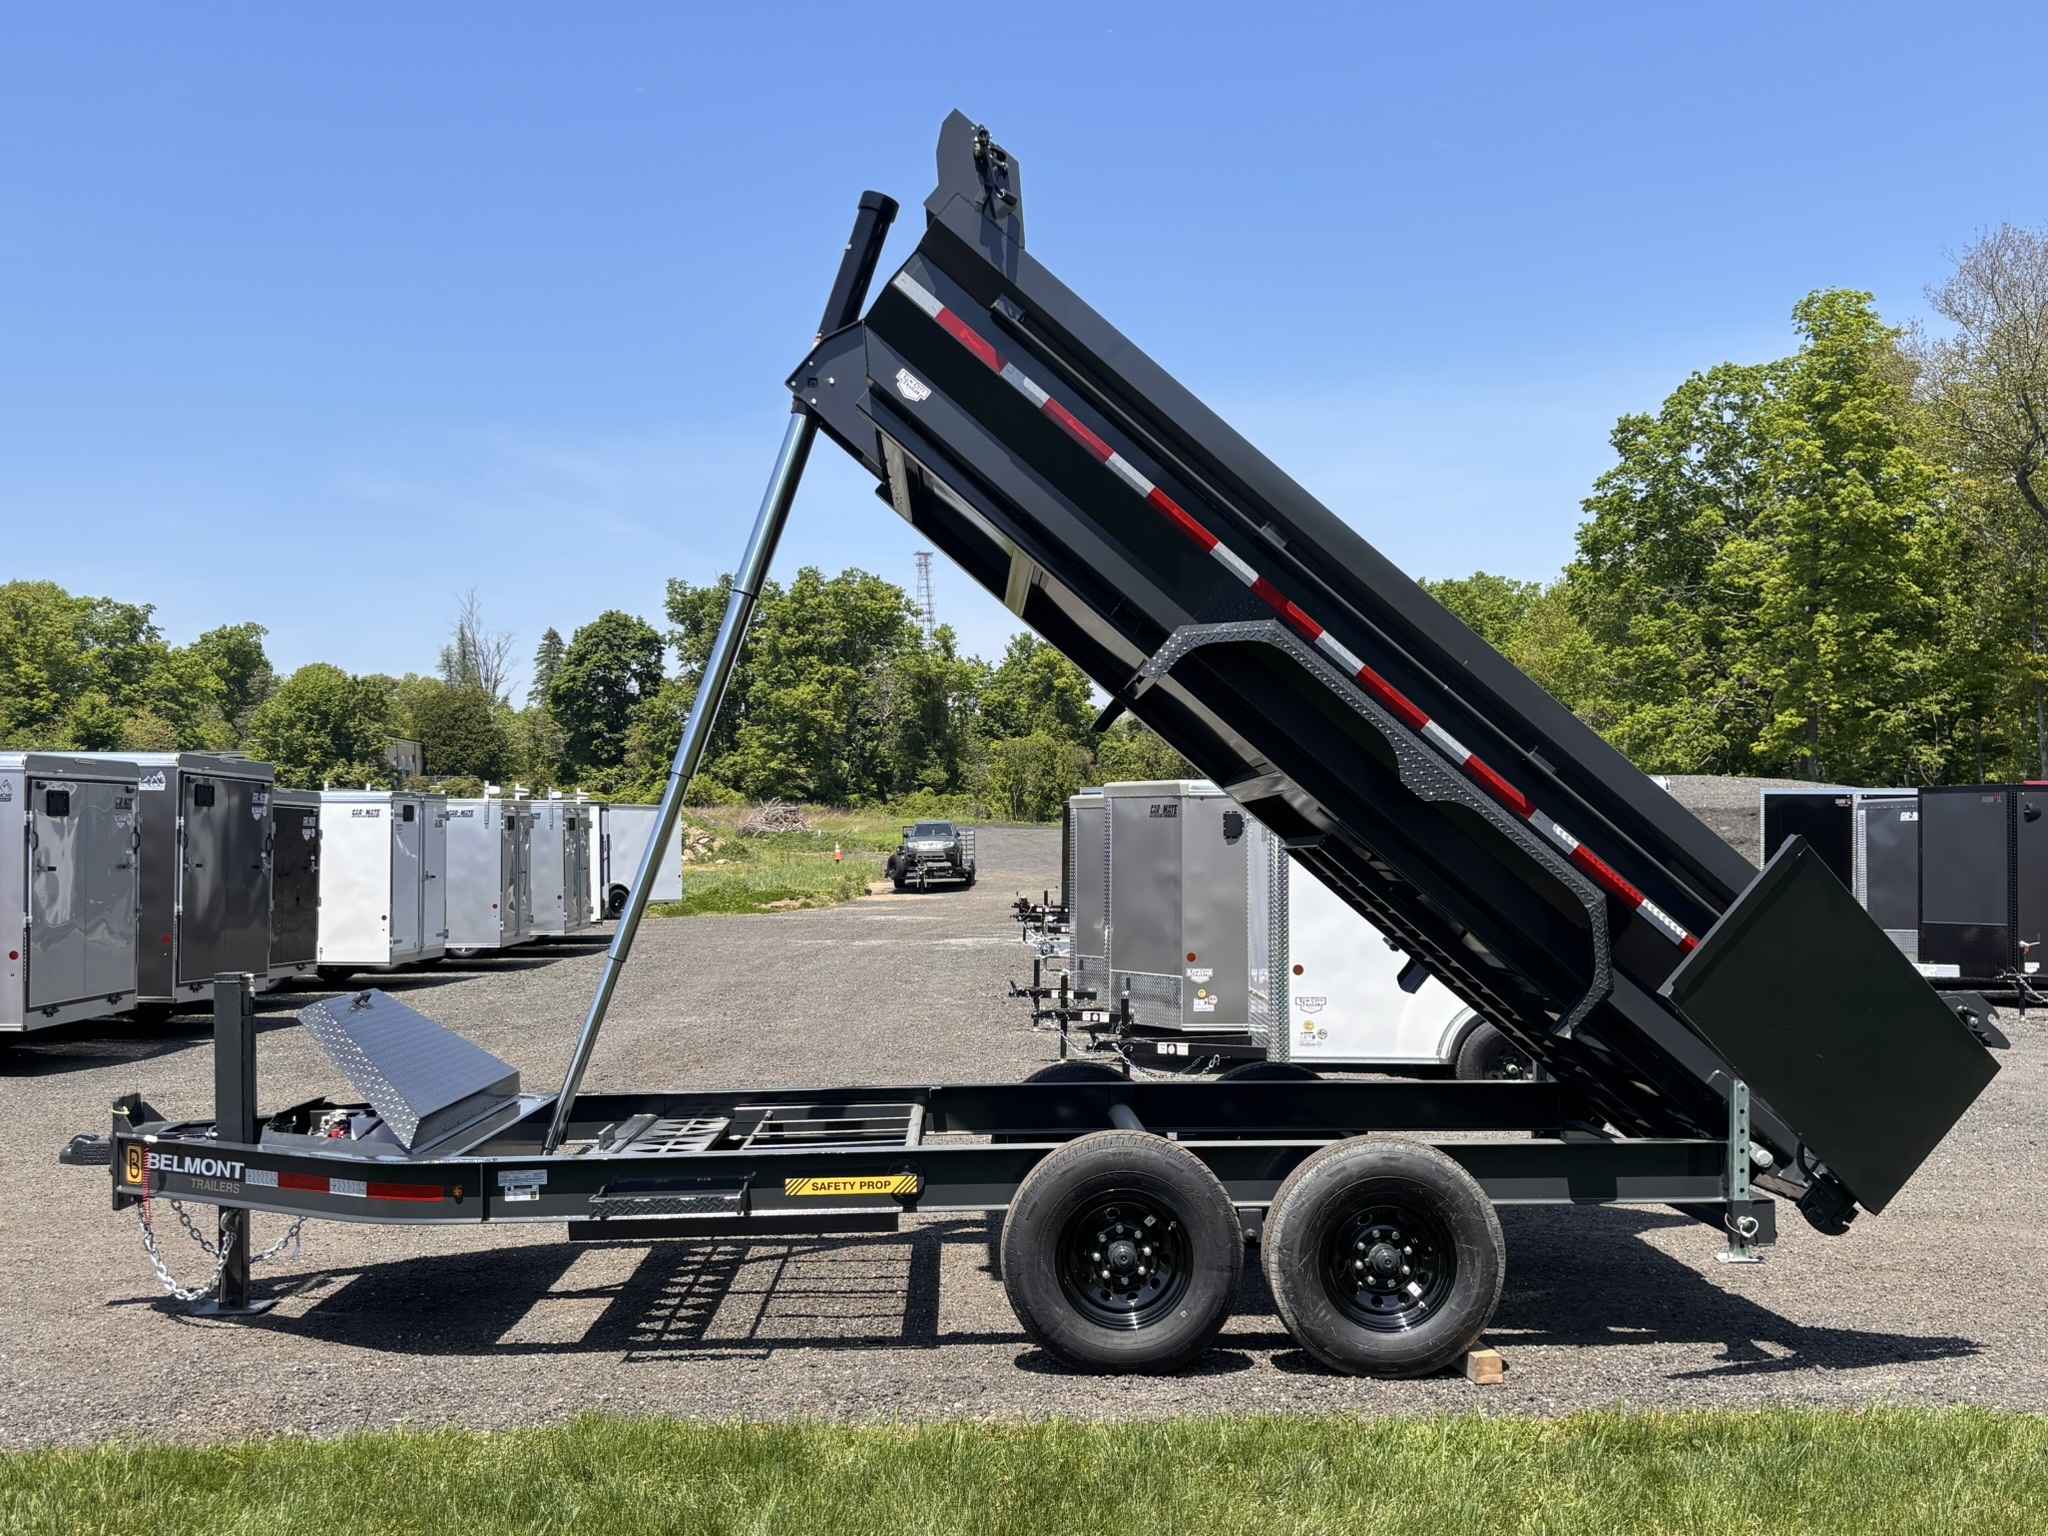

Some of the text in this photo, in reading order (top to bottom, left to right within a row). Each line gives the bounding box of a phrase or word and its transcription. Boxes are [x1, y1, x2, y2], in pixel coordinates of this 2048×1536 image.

[149, 1152, 245, 1179] BELMONT
[190, 1178, 241, 1194] TRAILERS
[811, 1180, 892, 1191] SAFETY PROP
